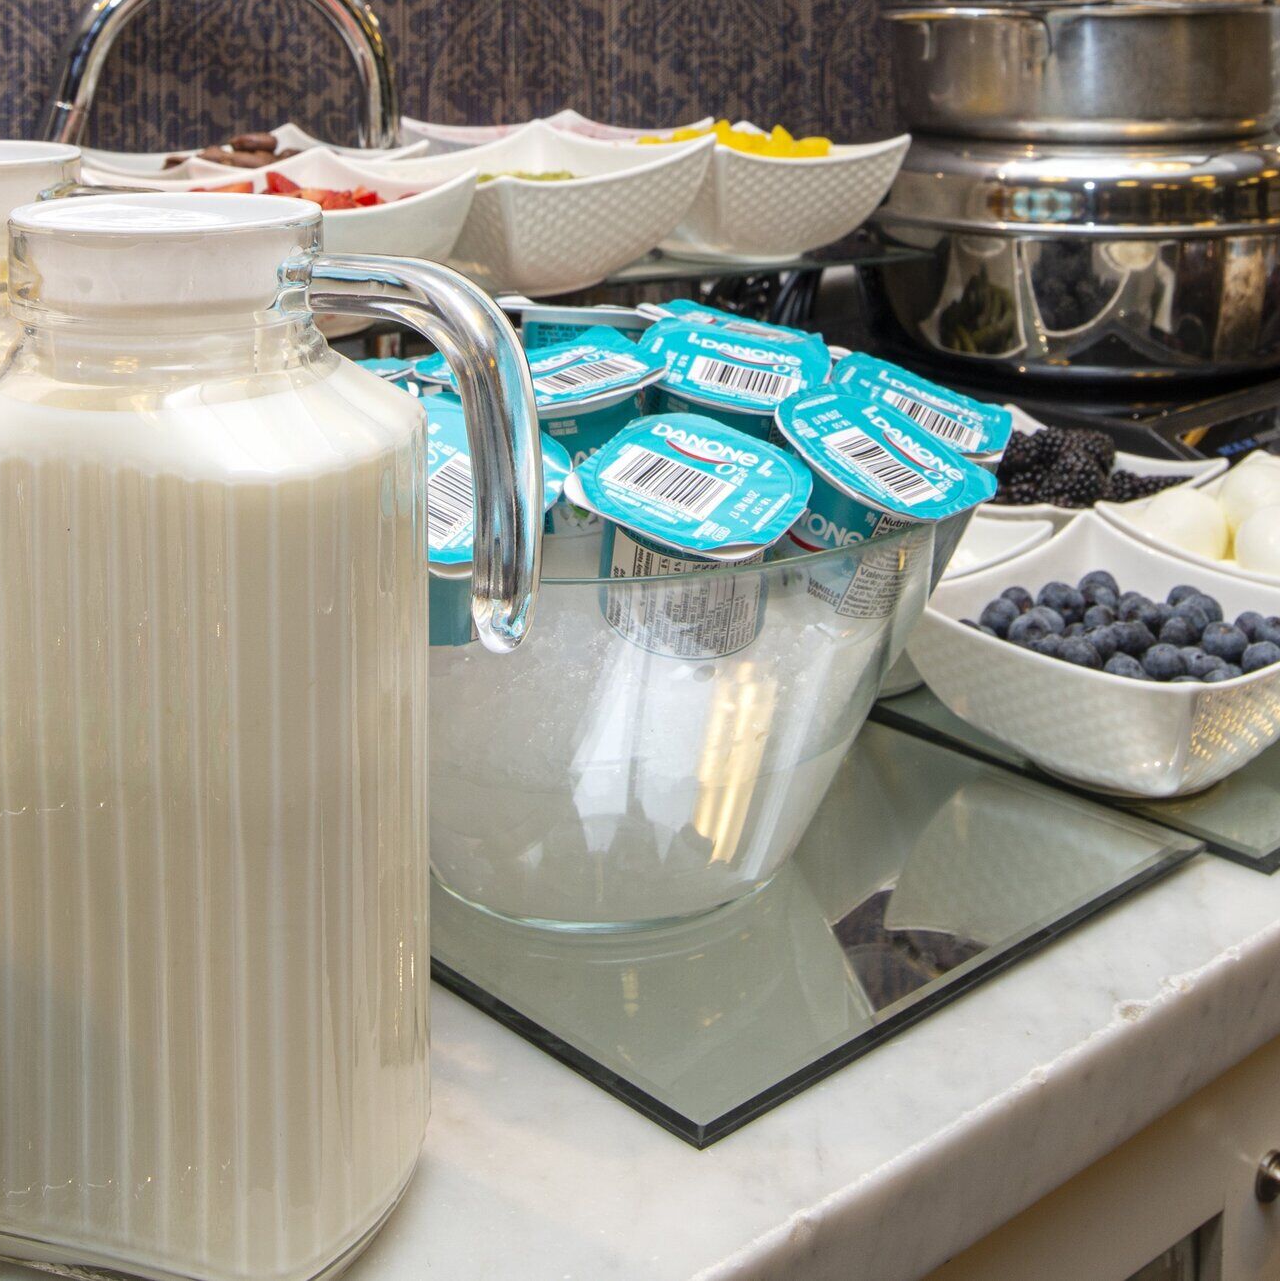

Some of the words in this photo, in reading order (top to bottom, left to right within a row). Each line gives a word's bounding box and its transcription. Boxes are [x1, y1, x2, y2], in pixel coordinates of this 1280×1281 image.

[700, 338, 802, 365] DANONE
[888, 378, 985, 421] DANONE
[651, 423, 759, 467] DANONE
[871, 419, 964, 481] DANONE
[807, 586, 839, 607] VANILLE
[810, 577, 841, 599] VANILLA
